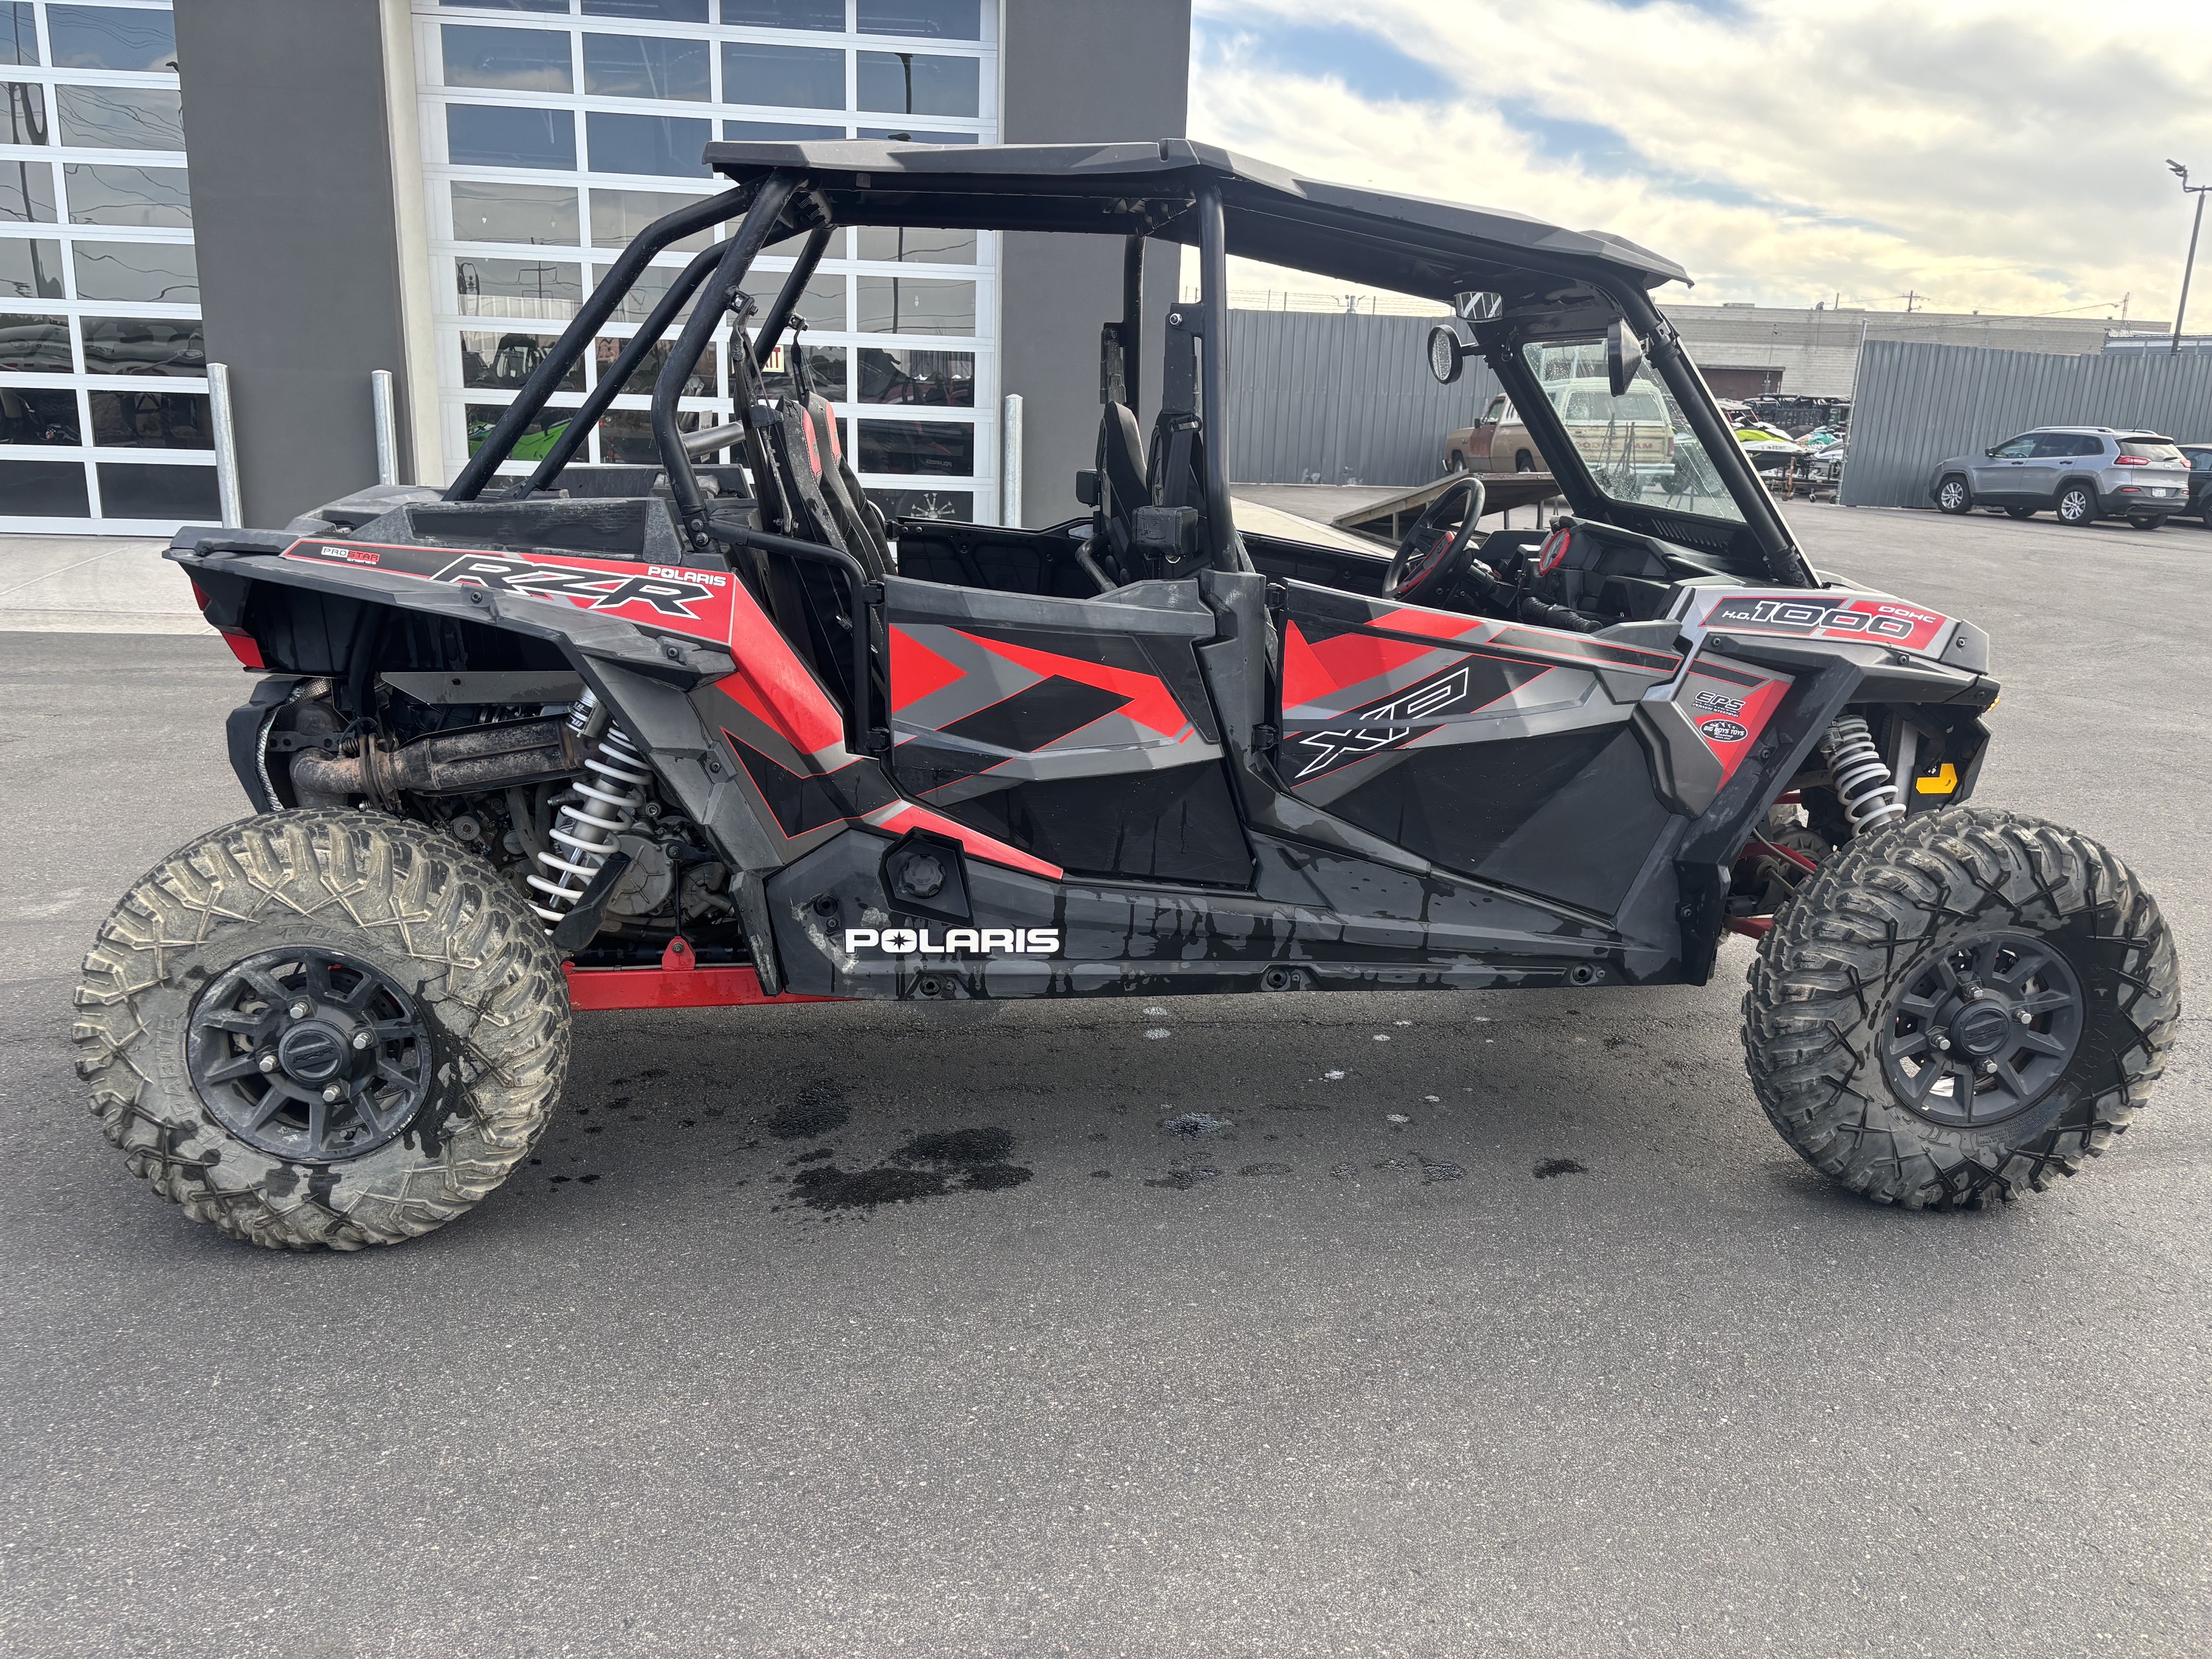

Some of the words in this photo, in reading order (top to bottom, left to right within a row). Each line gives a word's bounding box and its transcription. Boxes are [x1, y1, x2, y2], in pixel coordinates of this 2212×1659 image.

[428, 553, 716, 620] RZR
[647, 565, 727, 587] POLARIS
[1722, 610, 1751, 620] H.O.
[1750, 599, 1915, 641] 1000
[1877, 605, 1937, 623] DOHC
[1695, 690, 1747, 711] EPS
[1294, 666, 1469, 779] XP
[1714, 726, 1730, 735] BOYS
[844, 928, 1060, 954] POLARIS
